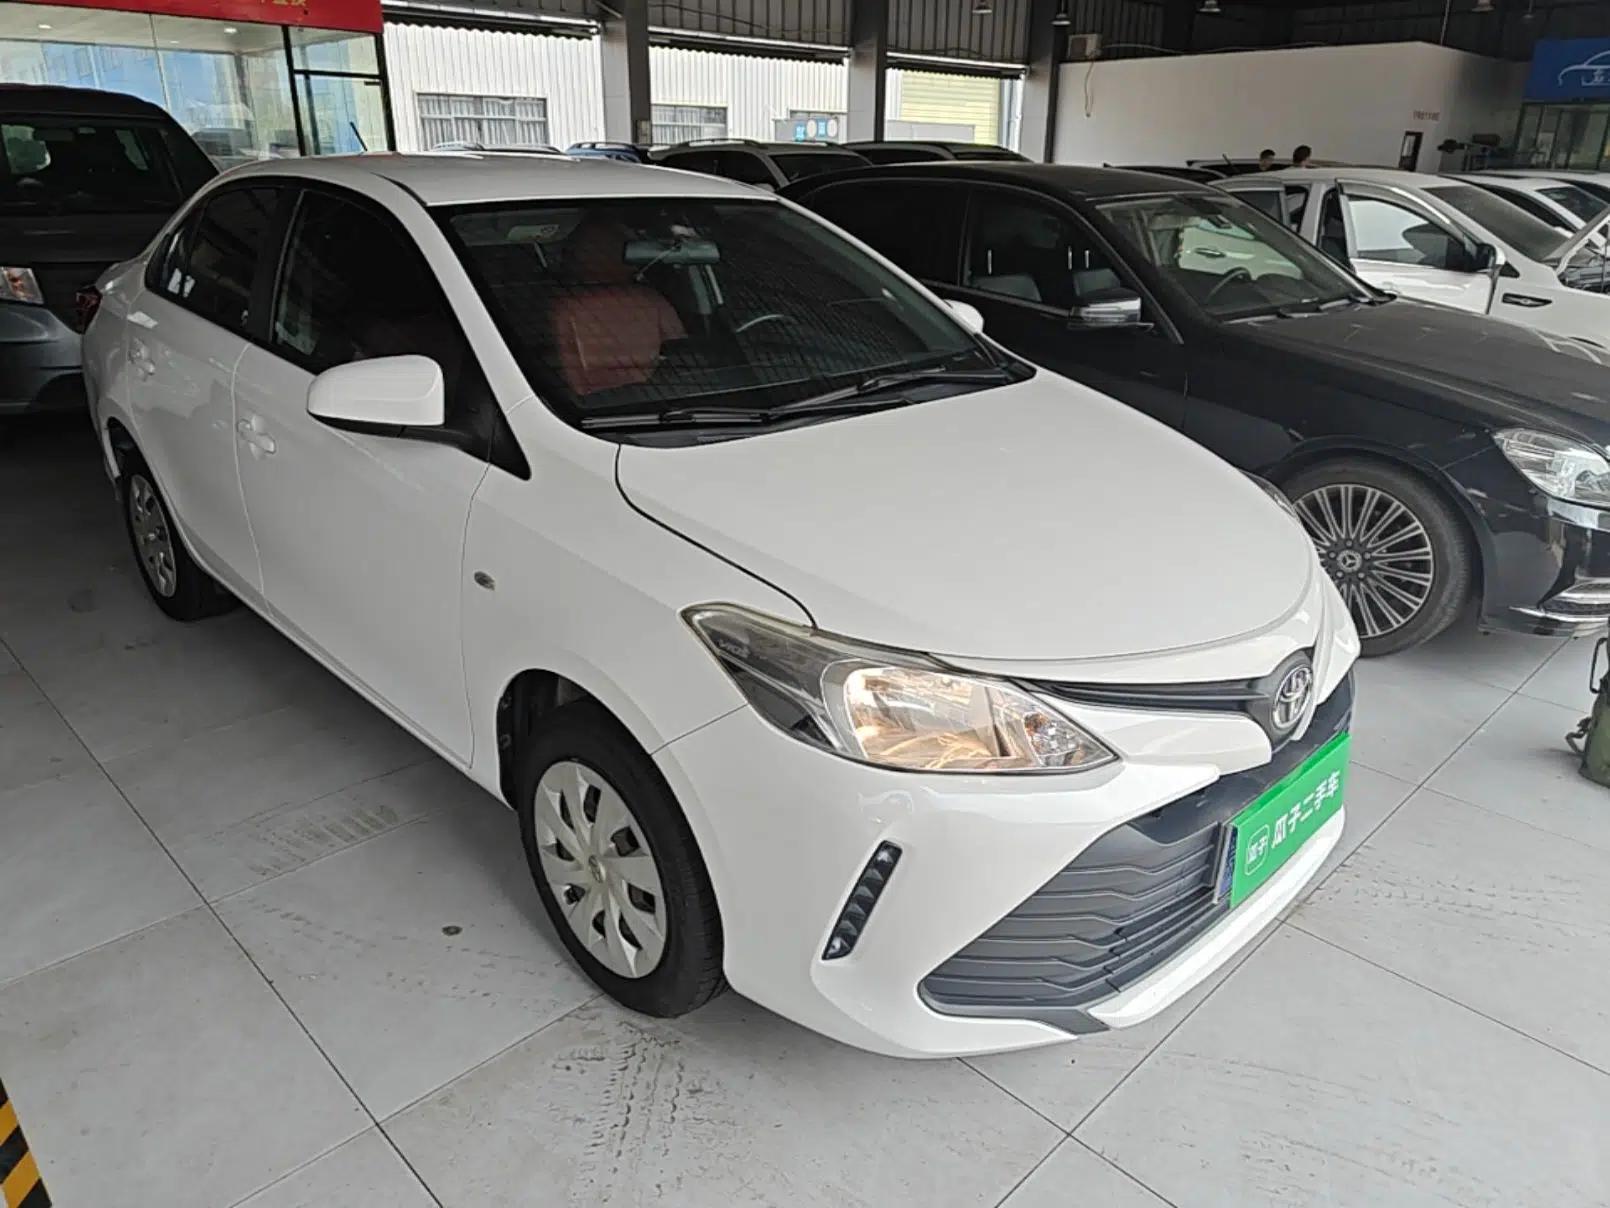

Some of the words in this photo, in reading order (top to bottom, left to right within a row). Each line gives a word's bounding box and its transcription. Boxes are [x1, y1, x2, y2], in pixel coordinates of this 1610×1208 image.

[1271, 770, 1340, 849] 瓜子二手车
